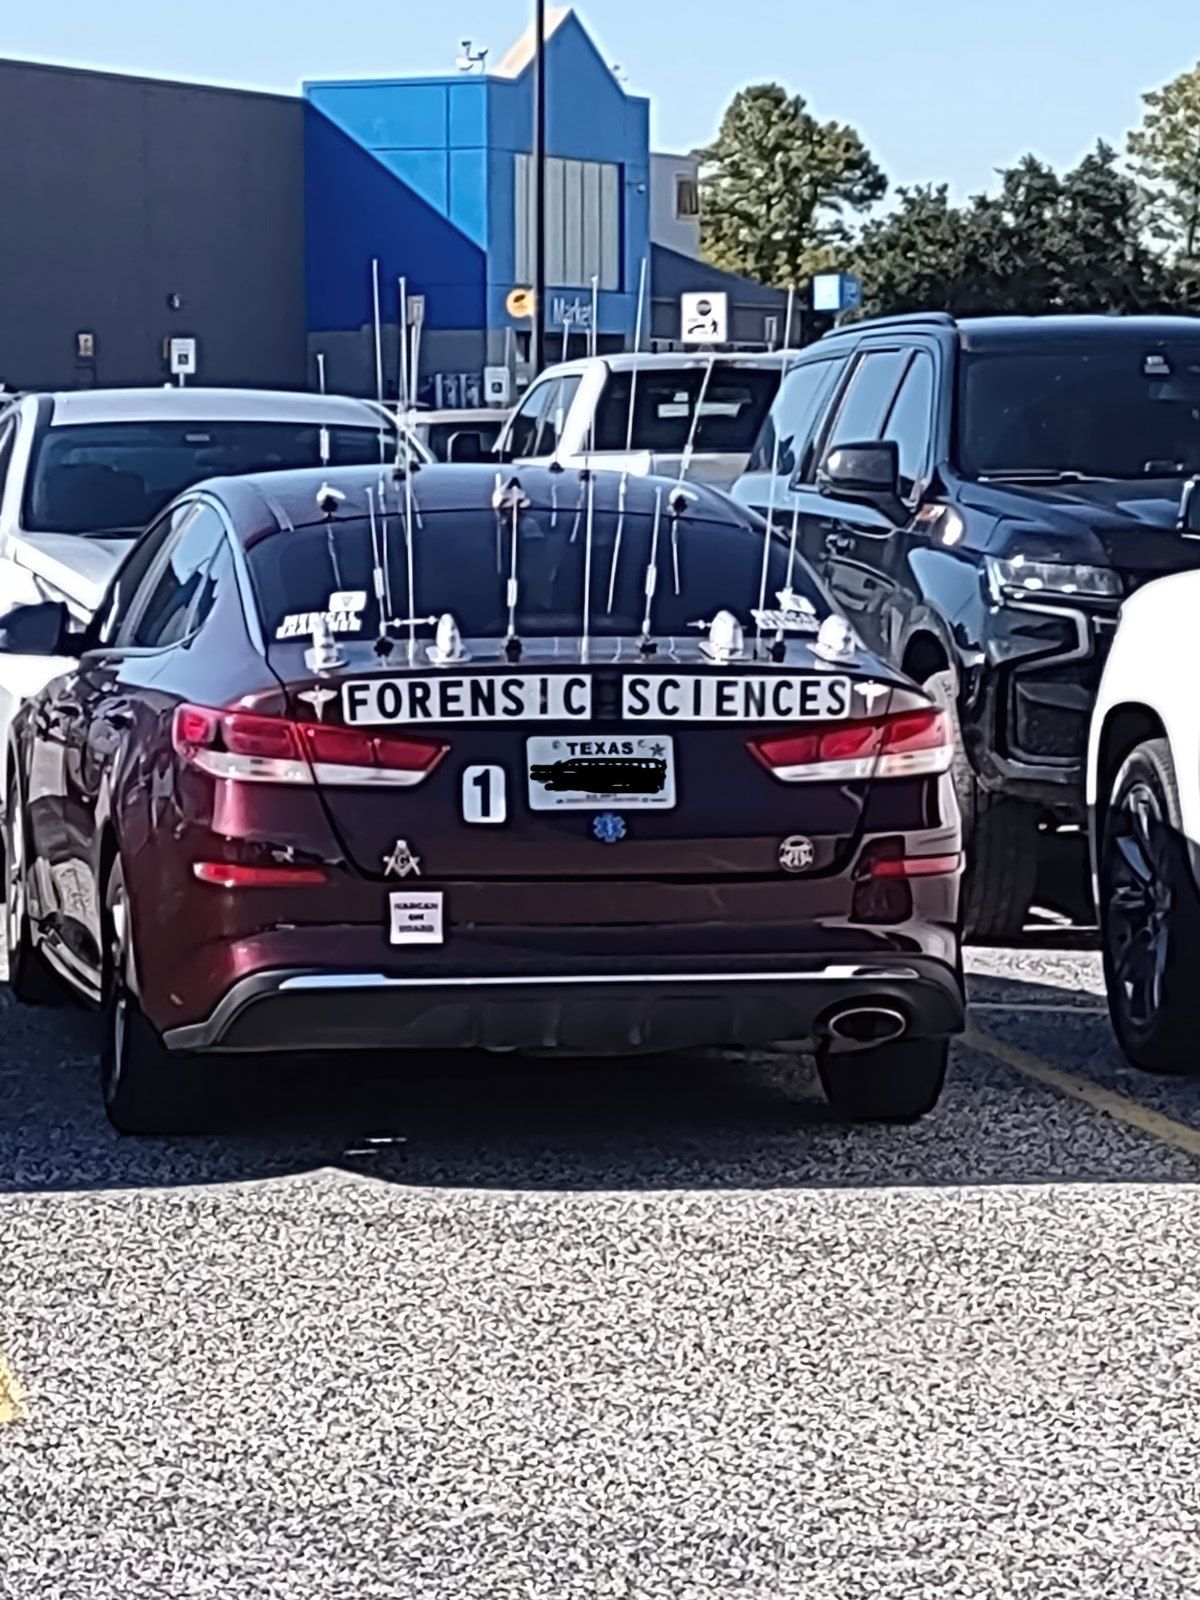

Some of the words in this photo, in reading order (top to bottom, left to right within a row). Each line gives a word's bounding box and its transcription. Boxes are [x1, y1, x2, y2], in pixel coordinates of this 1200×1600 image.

[347, 677, 588, 721] FORENSIC
[627, 678, 847, 718] SCIENCES
[566, 741, 634, 756] TEXAS
[472, 768, 491, 818] 1
